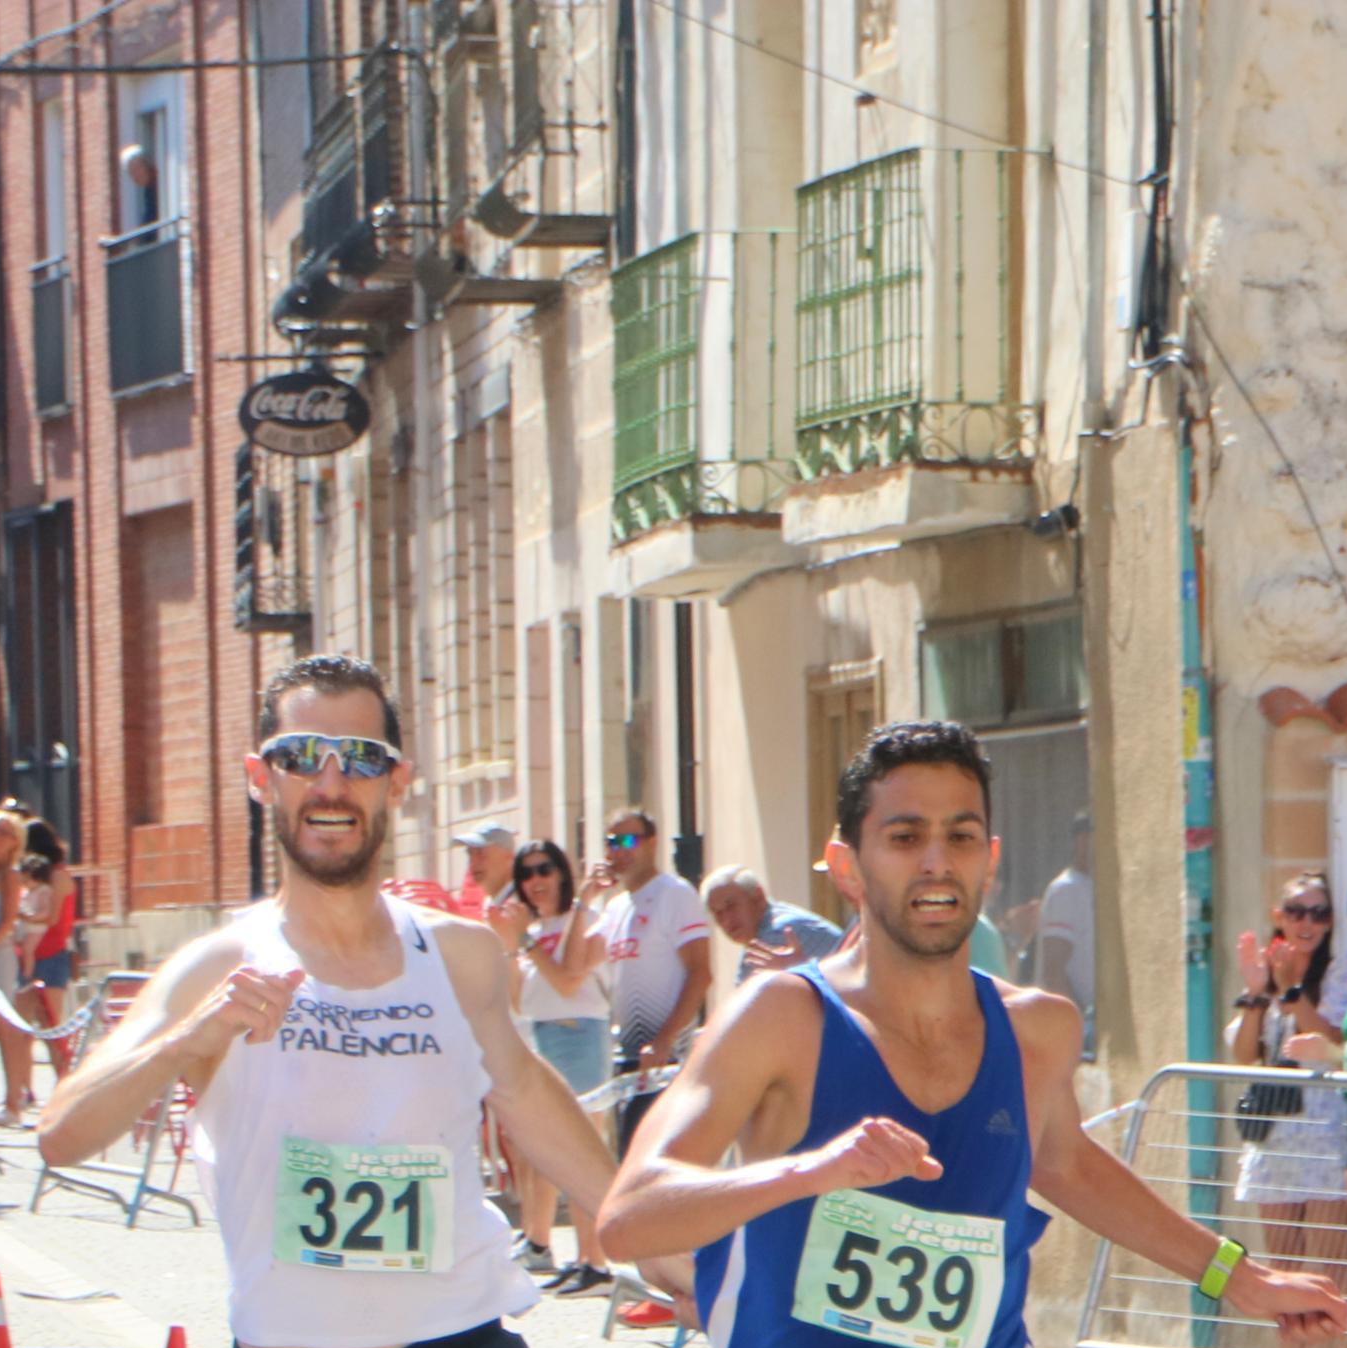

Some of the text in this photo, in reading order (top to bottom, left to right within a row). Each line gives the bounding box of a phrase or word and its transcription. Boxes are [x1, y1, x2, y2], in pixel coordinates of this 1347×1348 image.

[250, 384, 349, 421] Coca-Cola
[287, 998, 435, 1033] ORRIENDO
[280, 1027, 442, 1058] PALENCIA
[299, 1176, 420, 1251] 321
[826, 1230, 974, 1333] 539
